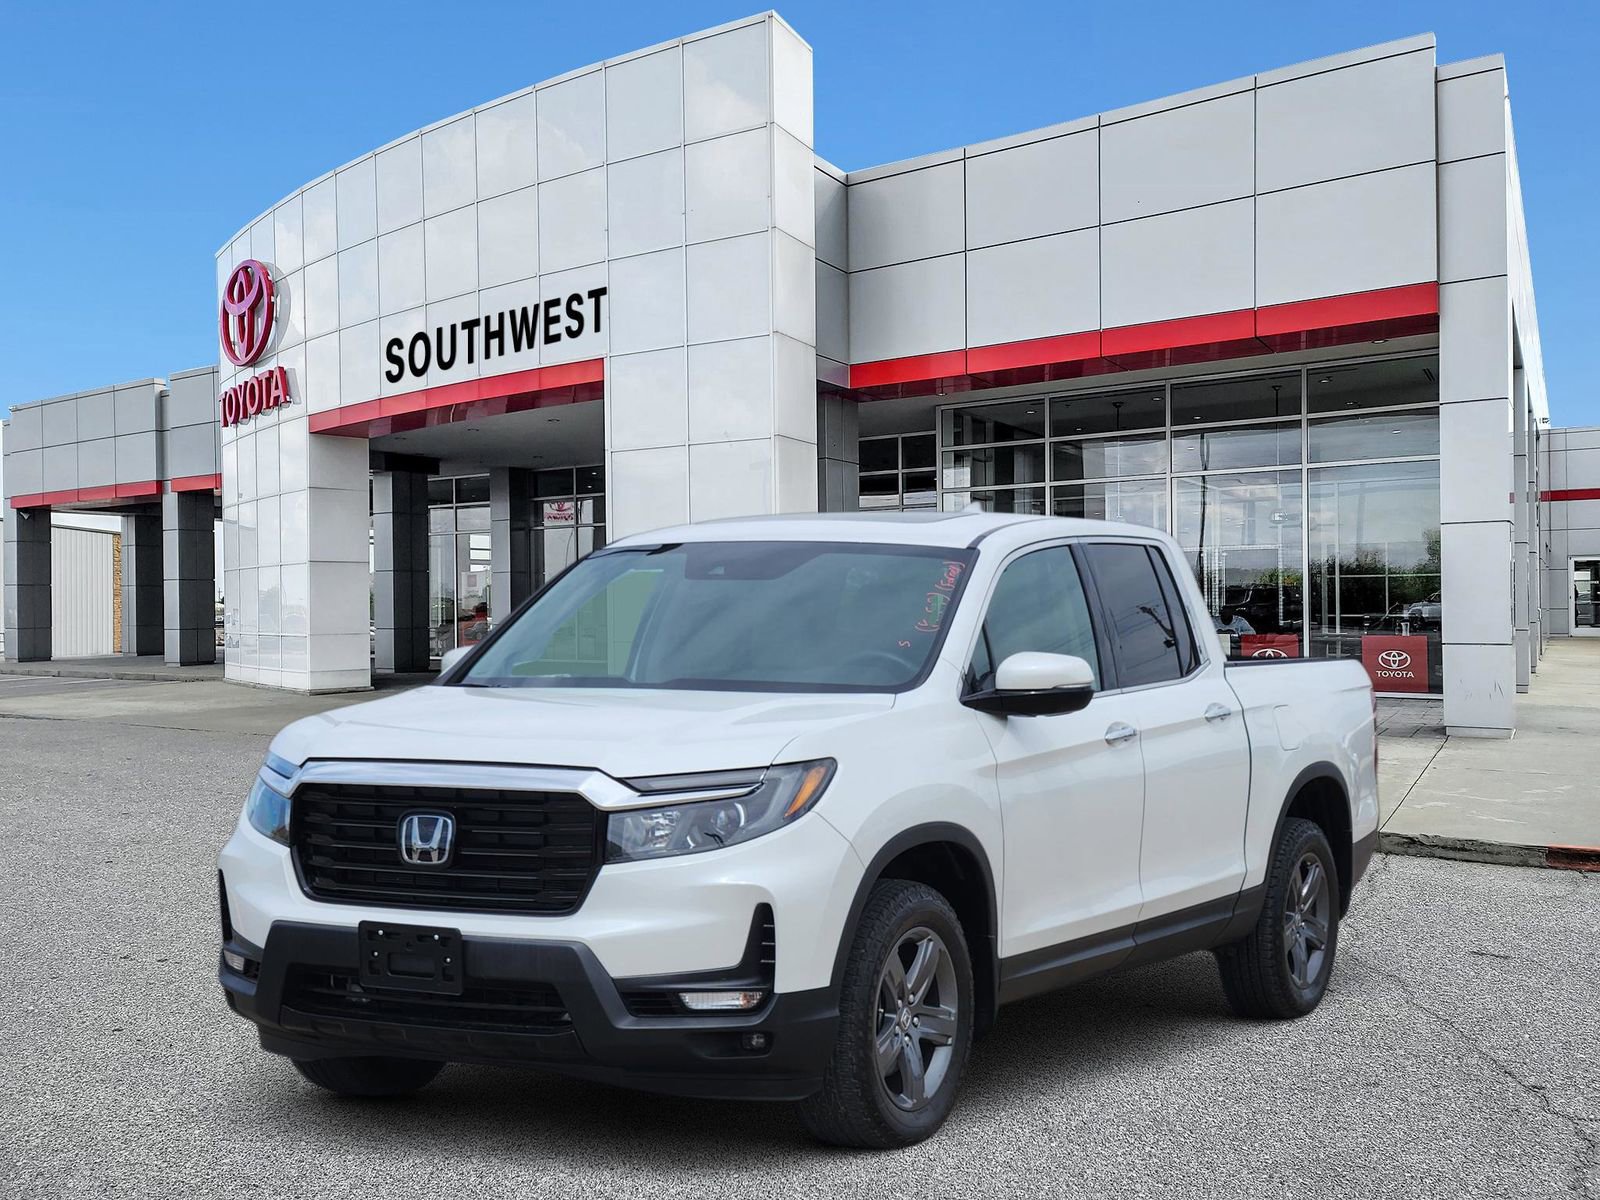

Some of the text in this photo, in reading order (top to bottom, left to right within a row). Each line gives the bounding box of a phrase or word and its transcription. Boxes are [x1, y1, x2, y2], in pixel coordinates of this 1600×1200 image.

[385, 287, 608, 384] SOUTHWEST
[218, 366, 290, 428] TOYOTA
[1375, 670, 1415, 678] TOYOTA
